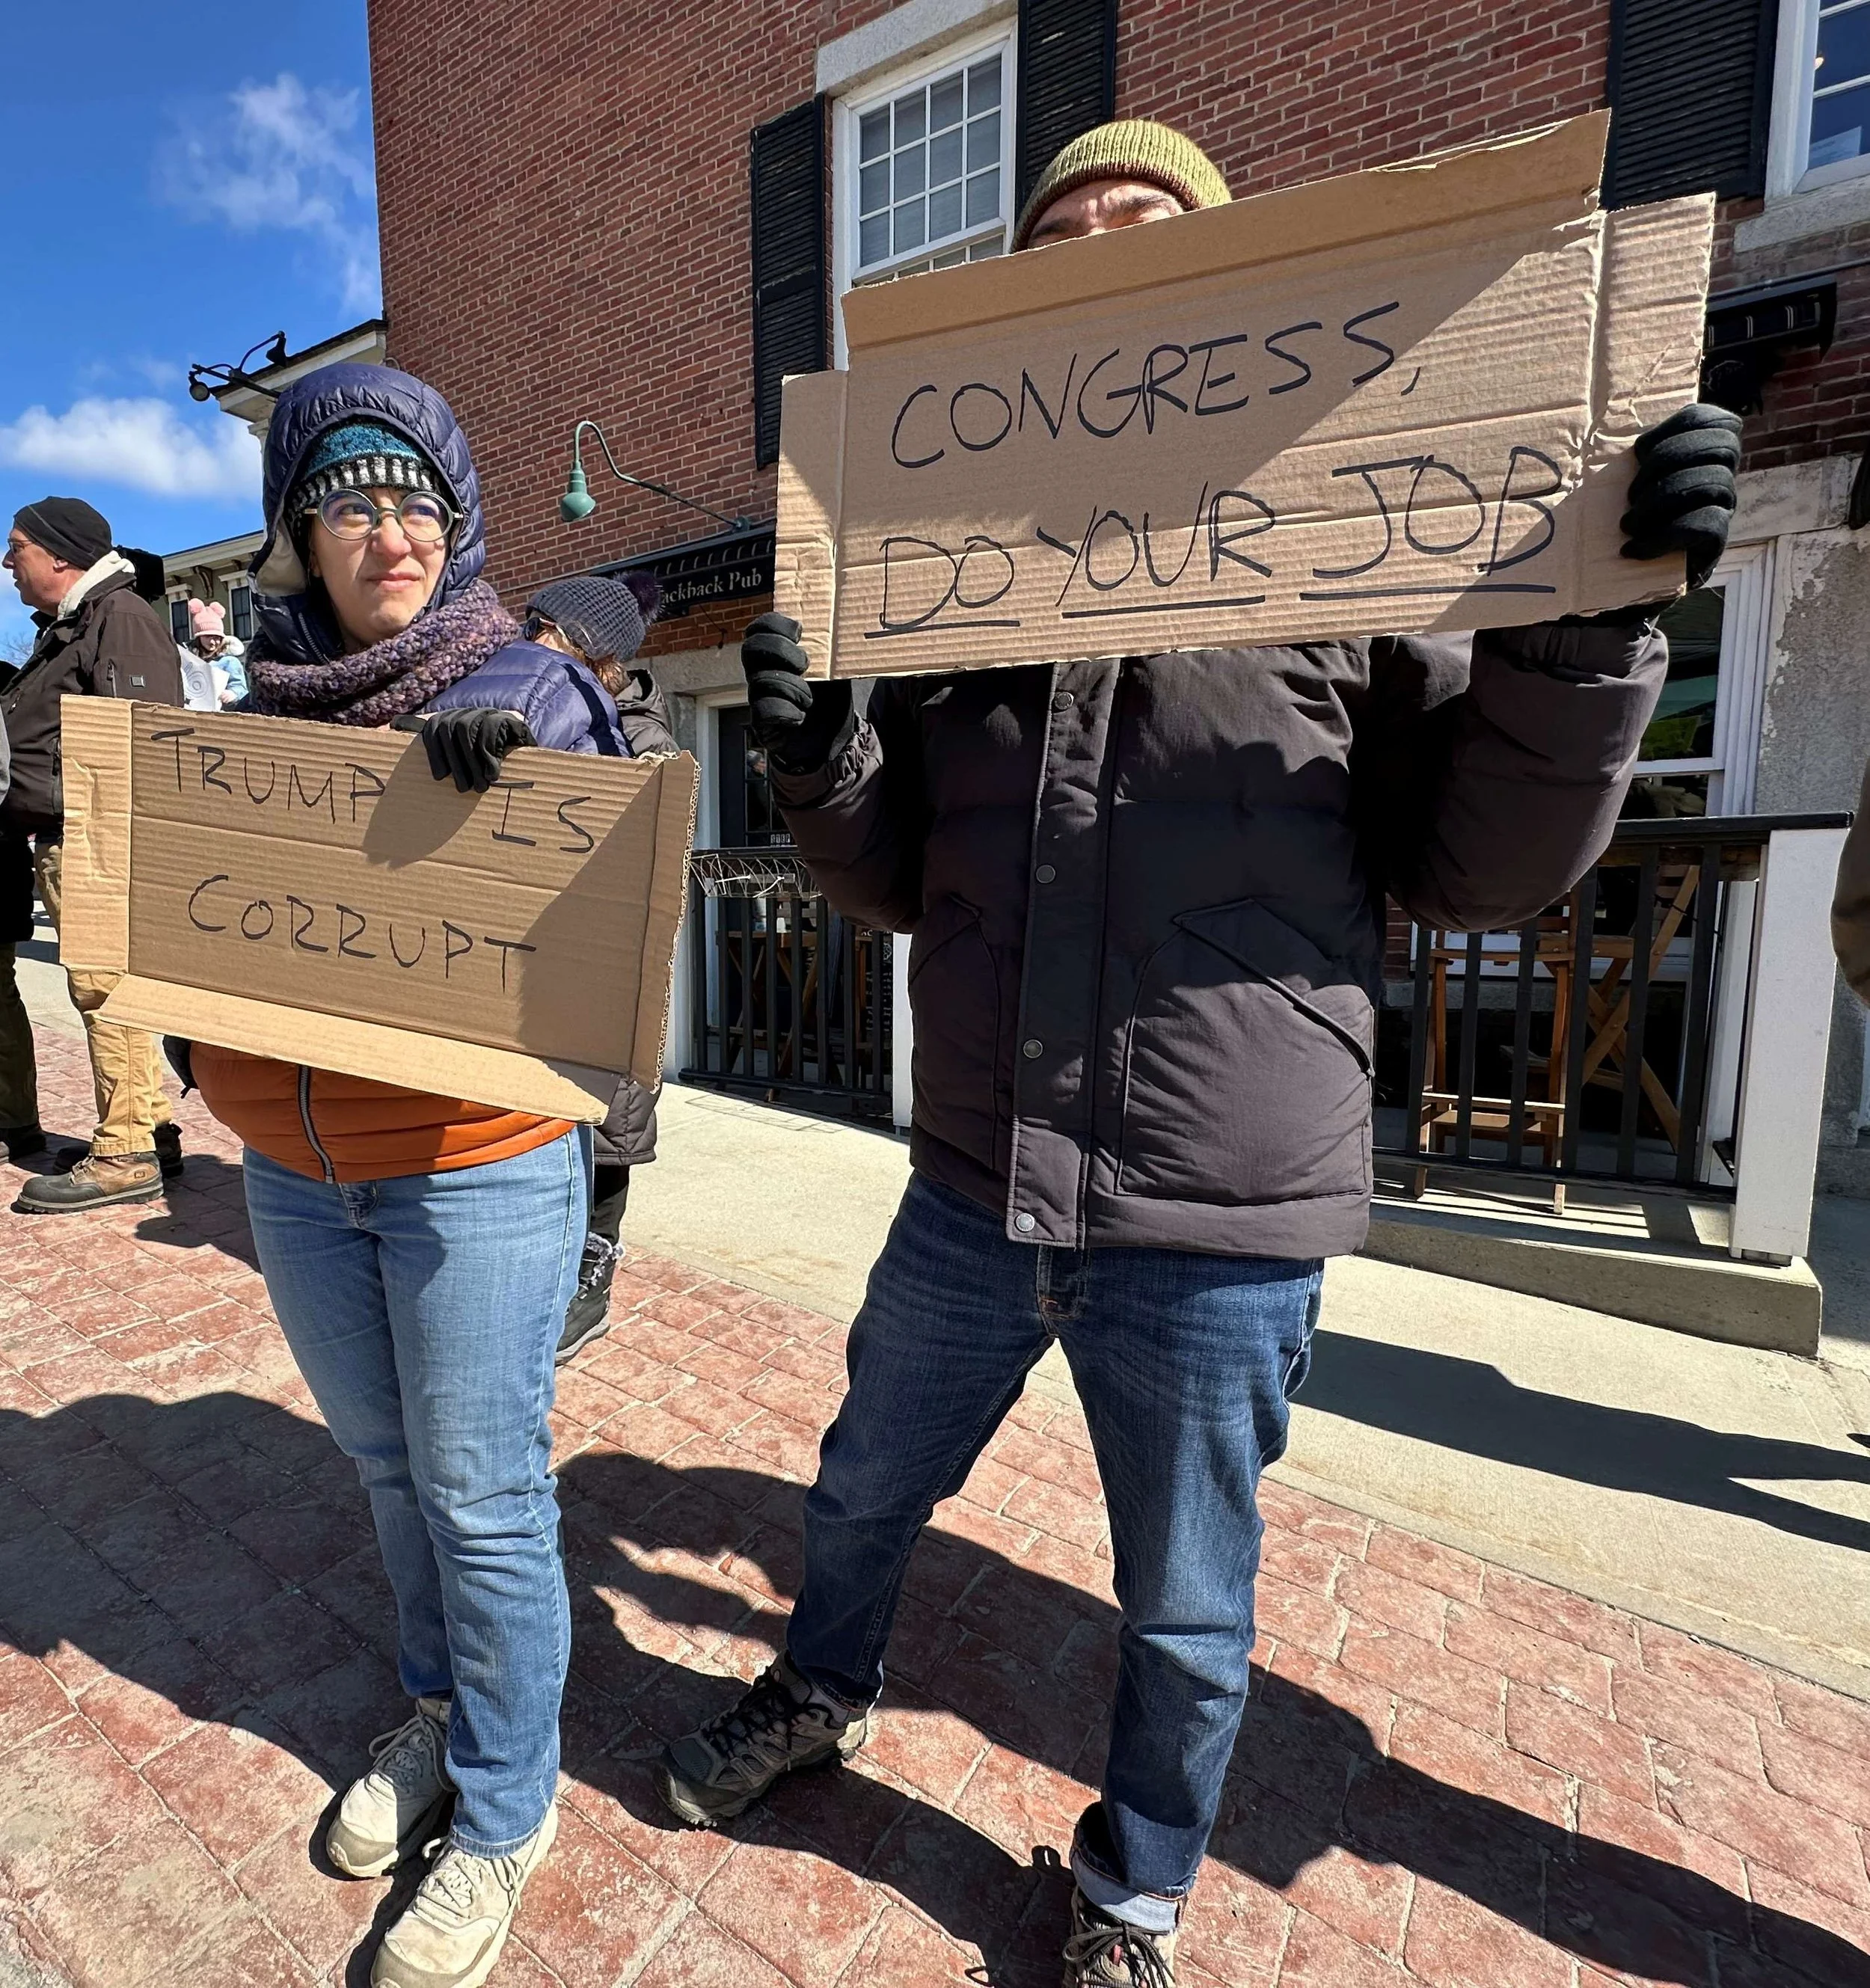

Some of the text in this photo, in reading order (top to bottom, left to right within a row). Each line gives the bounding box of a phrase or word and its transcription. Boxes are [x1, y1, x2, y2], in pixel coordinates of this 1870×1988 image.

[893, 302, 1421, 469] CONGRESS,
[661, 568, 761, 604] ackback Pub
[880, 447, 1563, 630] DO YOUR JOB
[151, 728, 595, 853] TRUMP IS
[188, 874, 536, 994] CORRUPT
